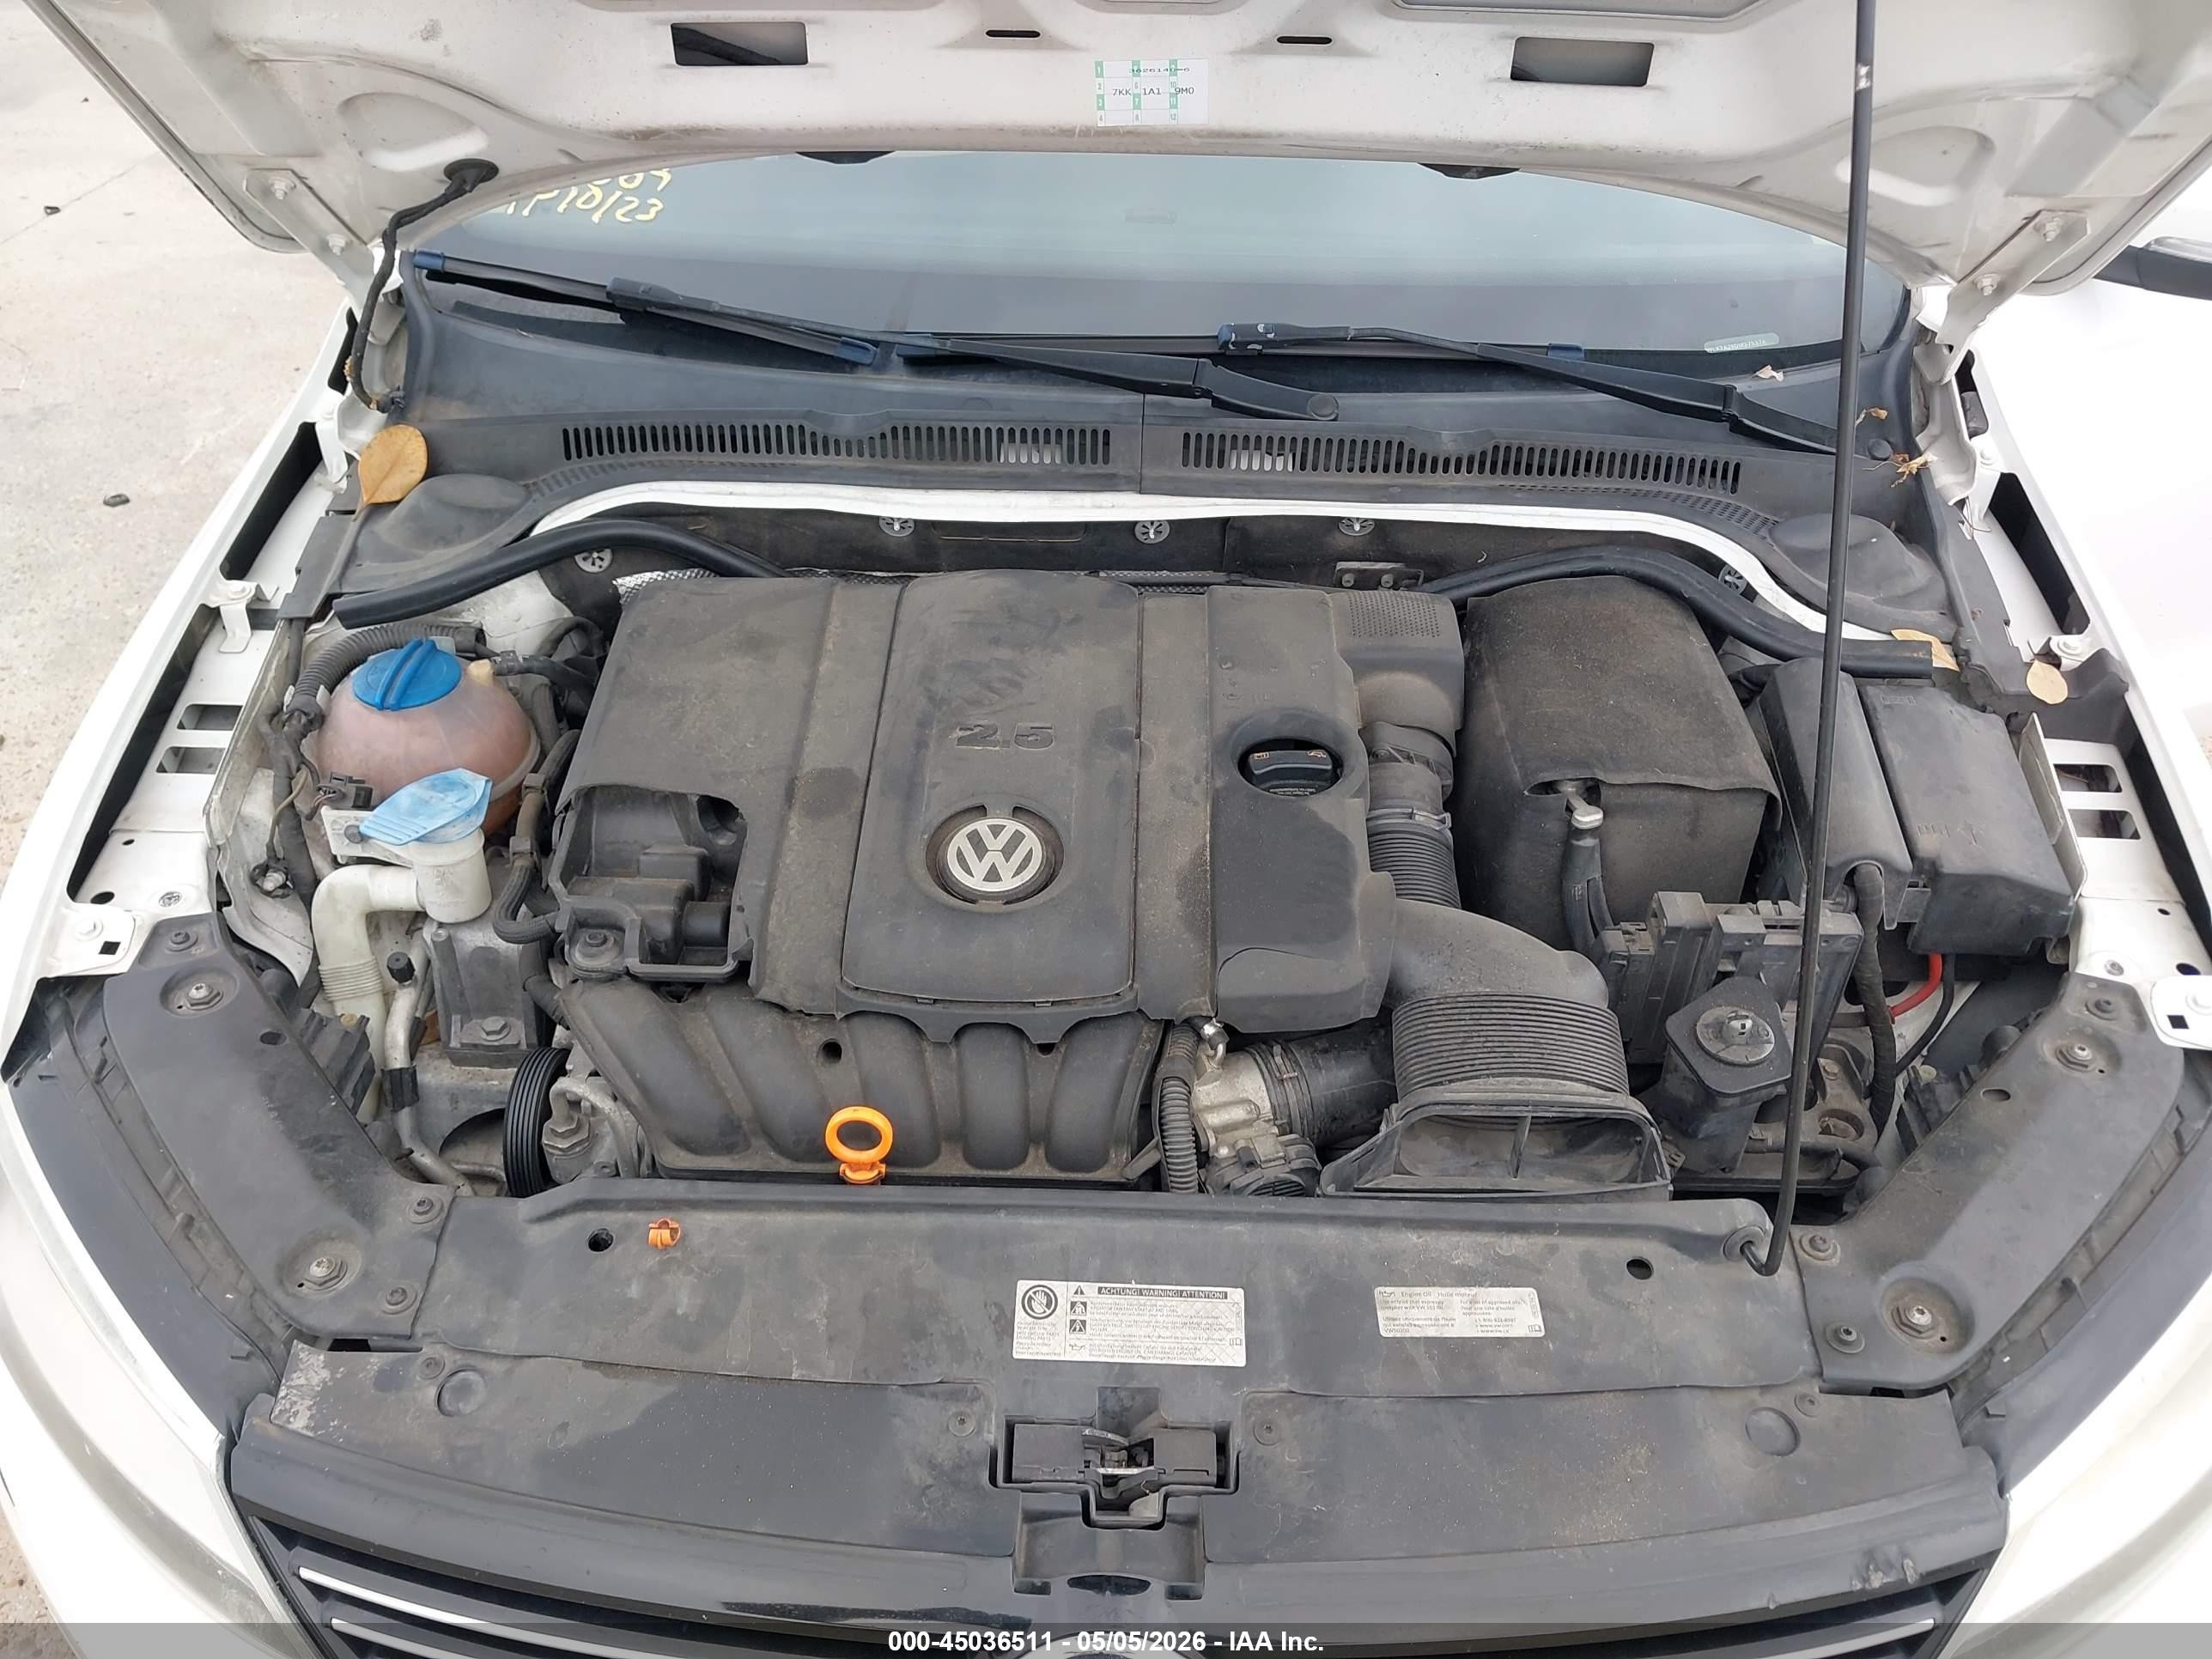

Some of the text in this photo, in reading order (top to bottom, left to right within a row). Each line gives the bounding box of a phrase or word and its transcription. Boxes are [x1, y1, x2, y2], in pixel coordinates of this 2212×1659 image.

[956, 720, 1055, 750] 2.5
[947, 818, 1042, 892] VW
[1100, 1287, 1225, 1299] ACHTUNG! WARNING! ATTENTION!
